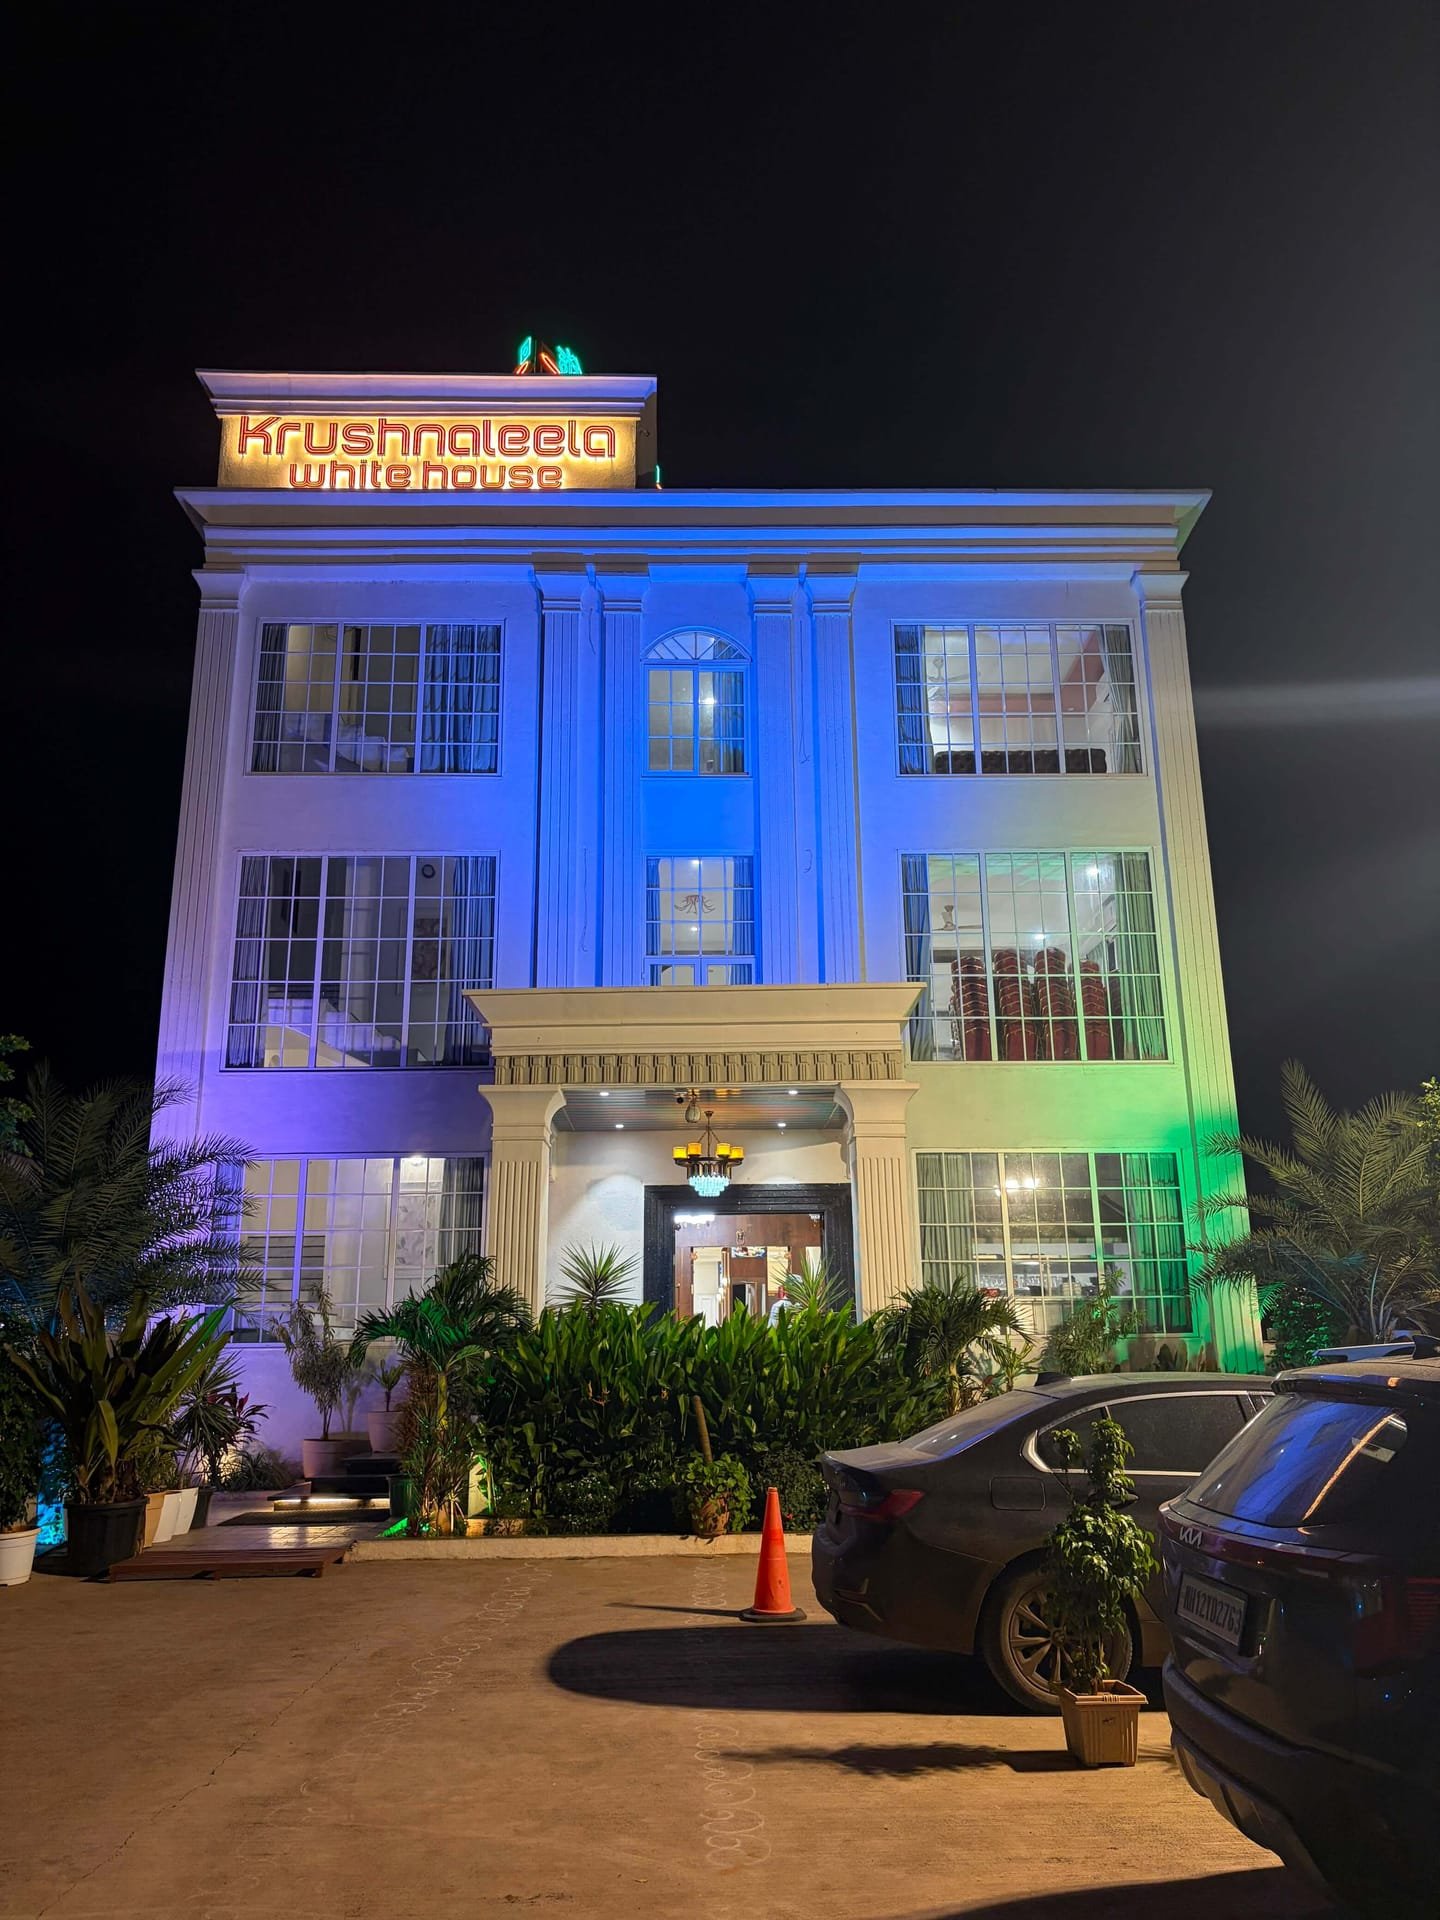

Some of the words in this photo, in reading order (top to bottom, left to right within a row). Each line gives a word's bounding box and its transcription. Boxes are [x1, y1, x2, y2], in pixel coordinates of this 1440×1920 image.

[238, 415, 617, 457] Krushnaleela
[289, 460, 412, 489] white
[422, 461, 563, 489] house
